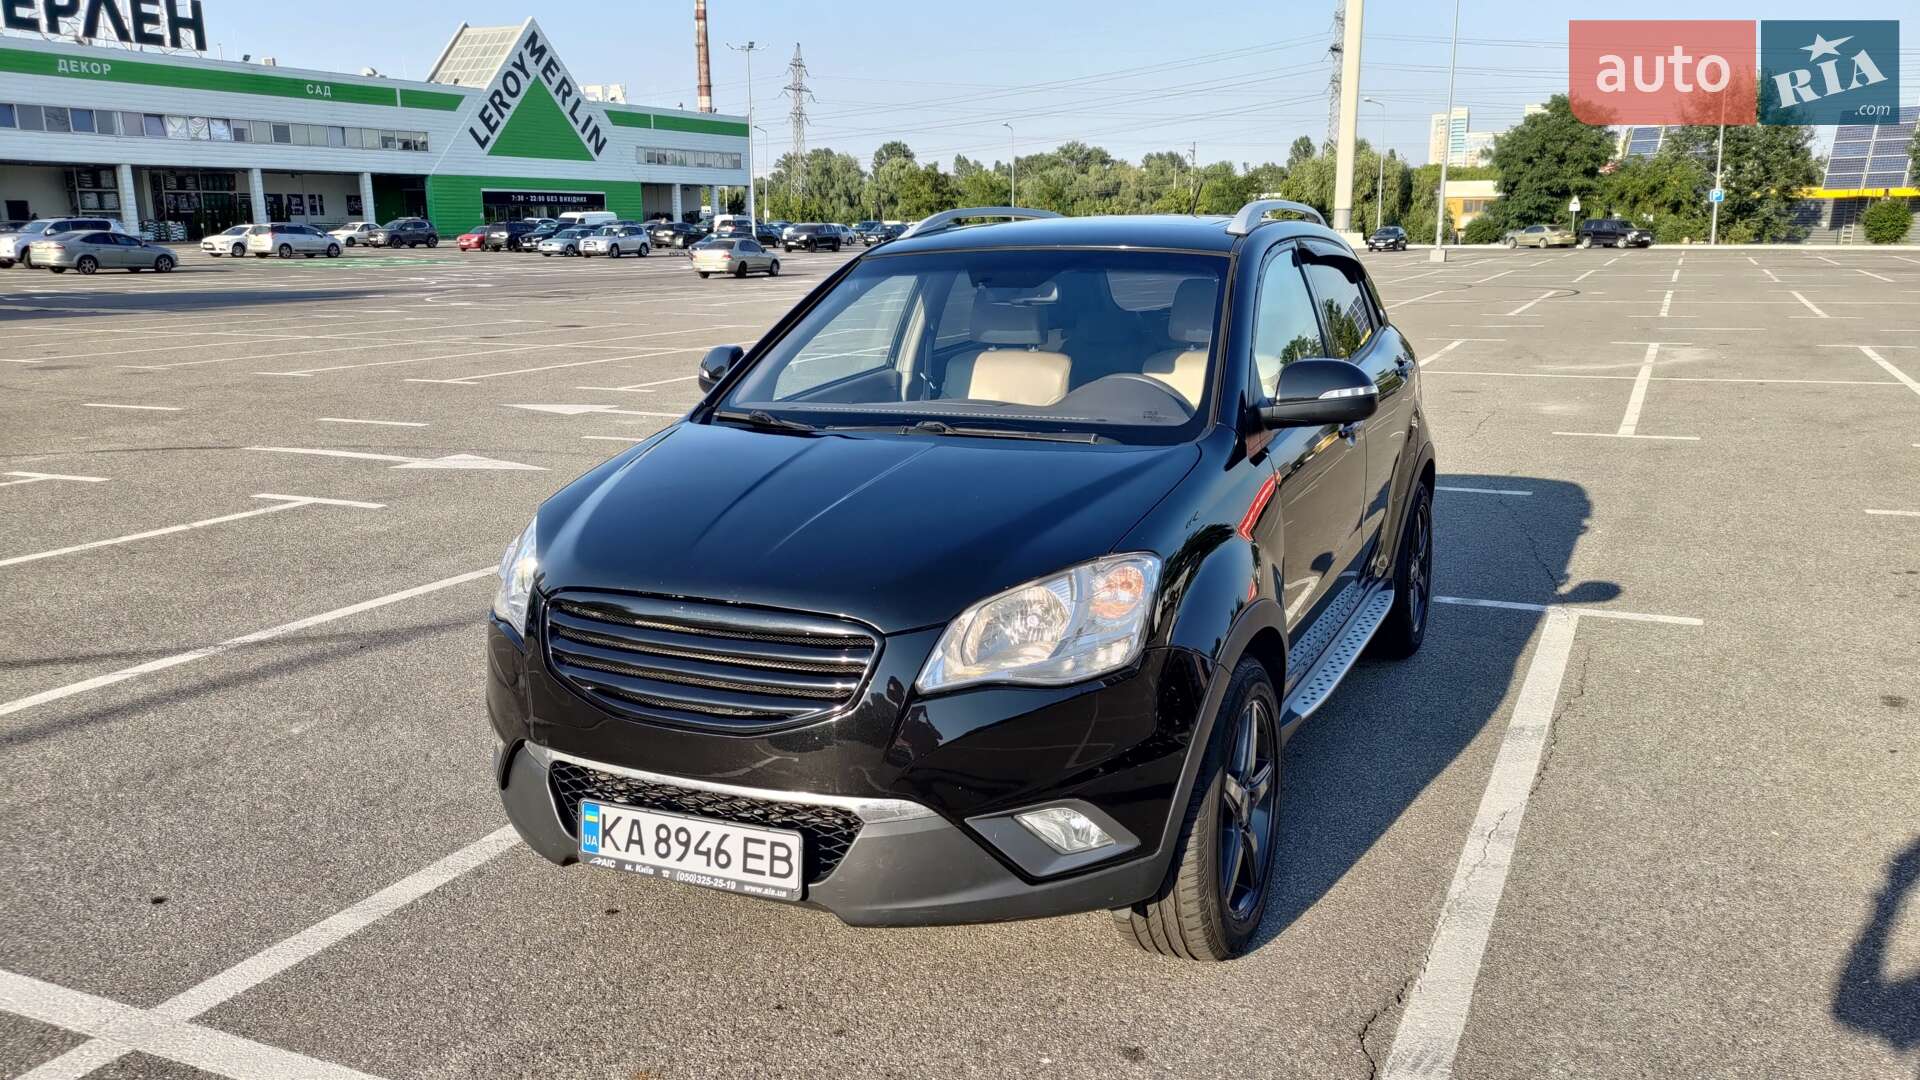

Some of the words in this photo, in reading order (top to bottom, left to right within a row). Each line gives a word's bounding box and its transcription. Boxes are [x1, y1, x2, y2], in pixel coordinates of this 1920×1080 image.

[57, 58, 112, 75] ДЕКОР
[305, 83, 332, 97] САД
[468, 51, 531, 150] LEROY
[523, 30, 608, 156] MERLIN
[584, 835, 598, 847] UA
[654, 823, 732, 870] 8946
[676, 870, 737, 890] (050)325-25-19
